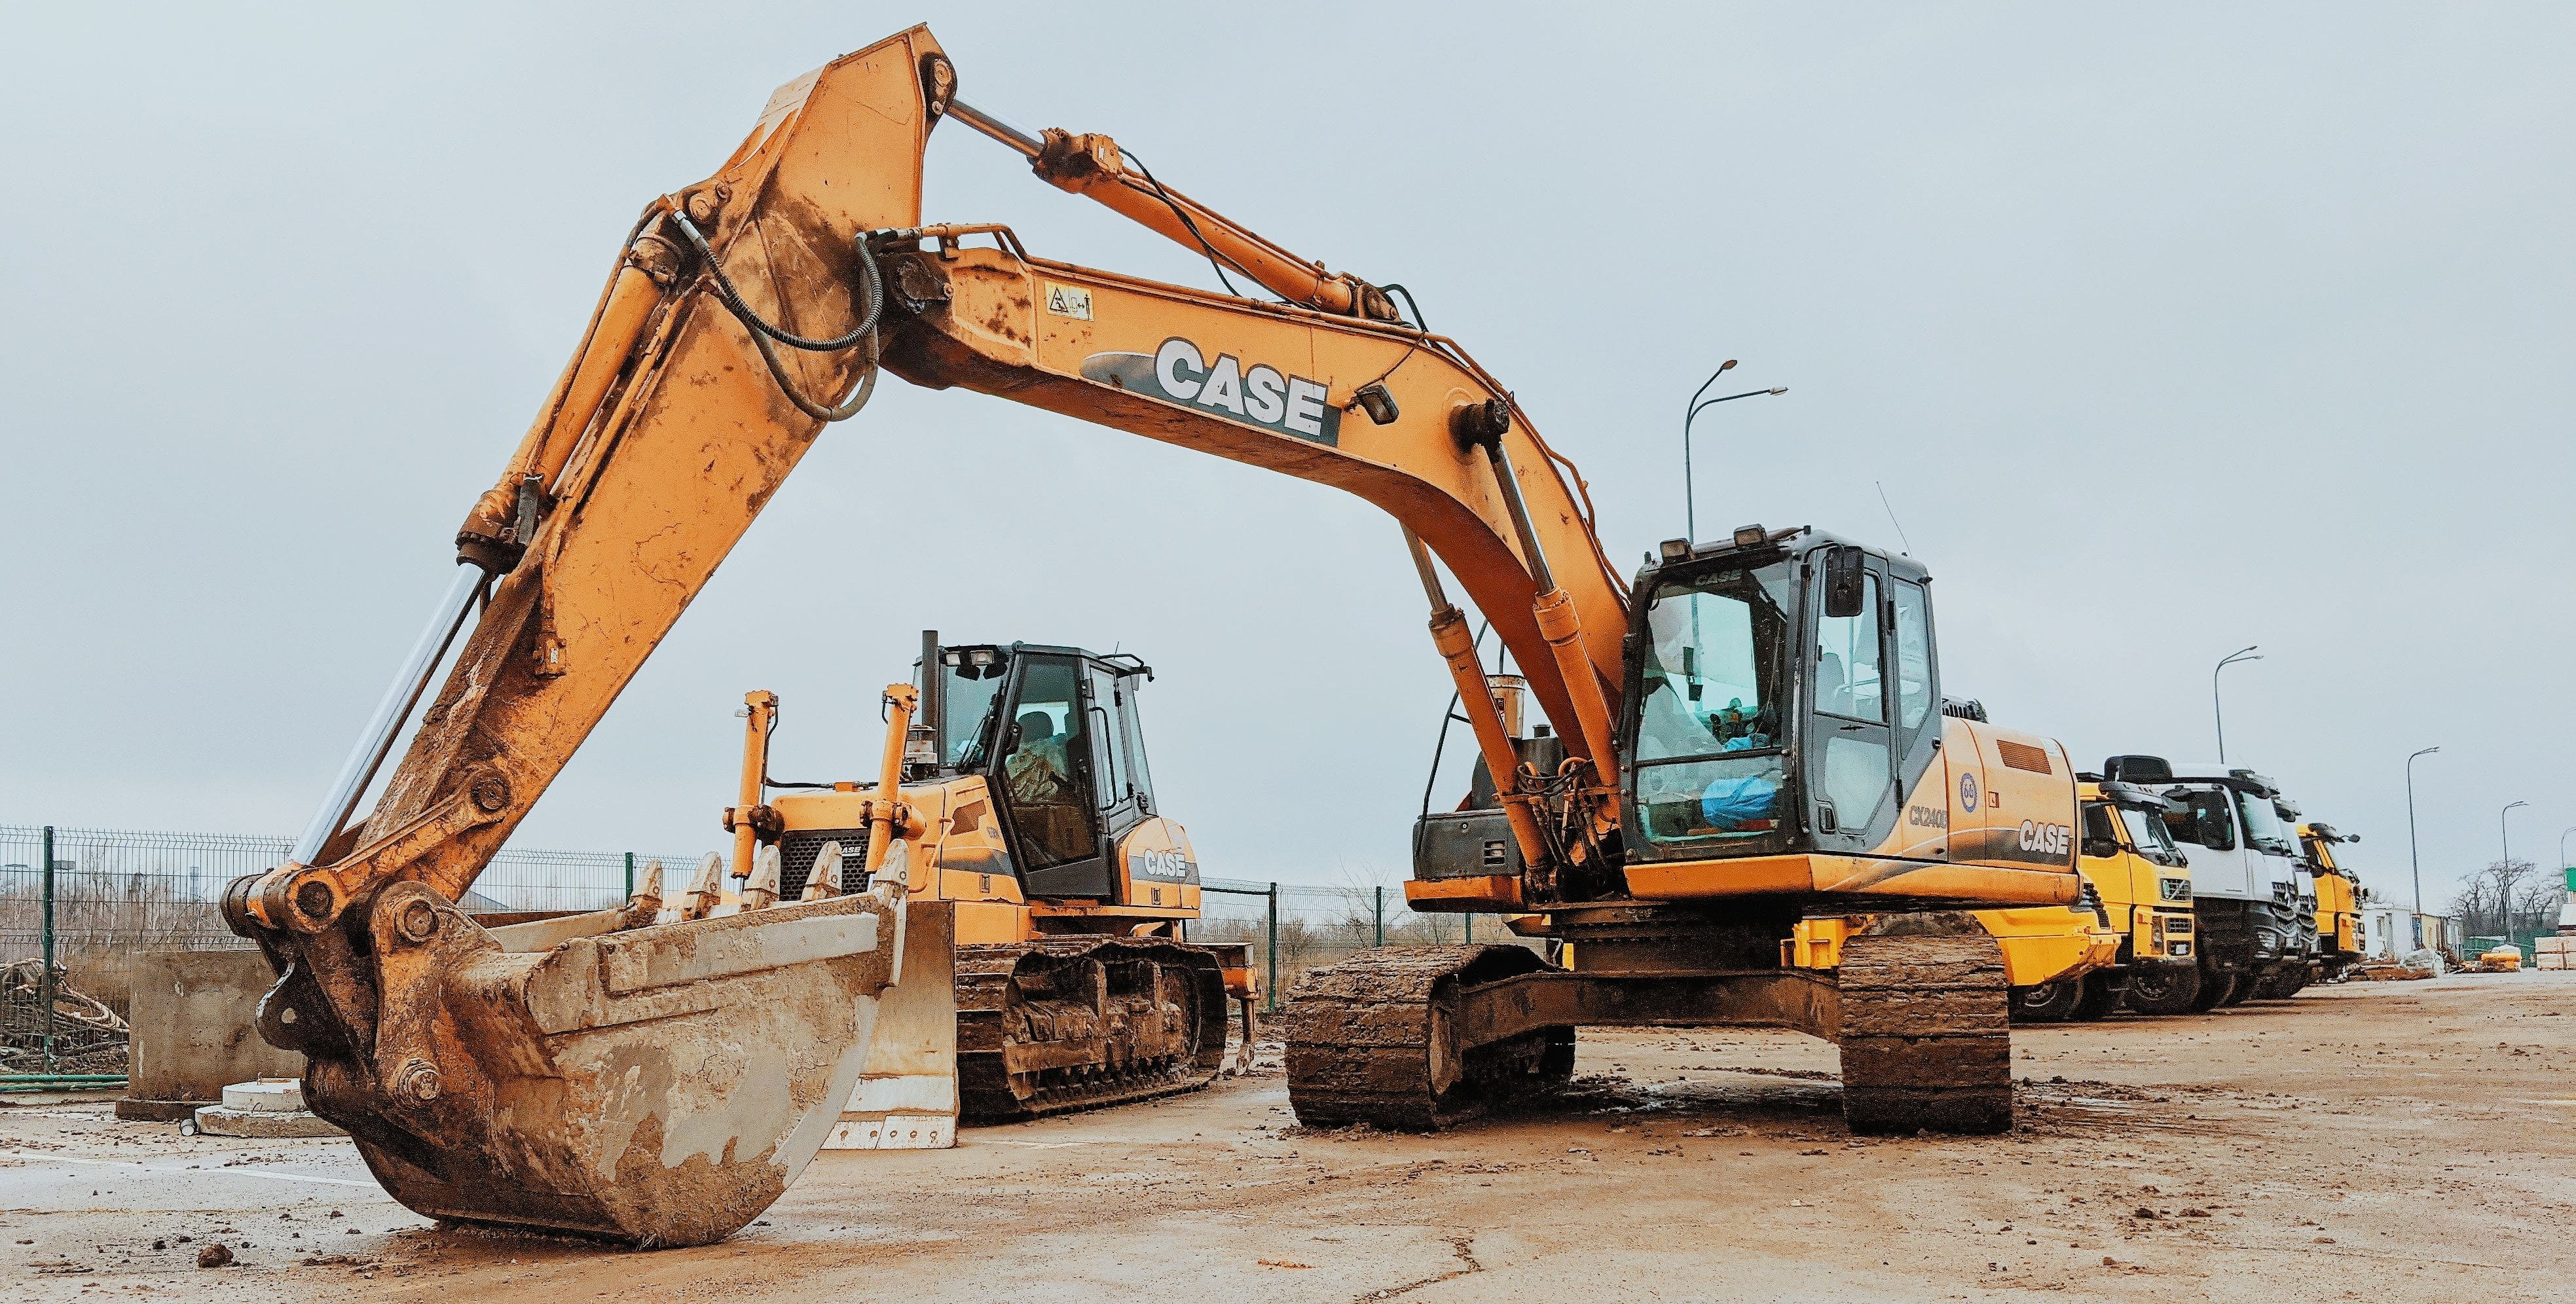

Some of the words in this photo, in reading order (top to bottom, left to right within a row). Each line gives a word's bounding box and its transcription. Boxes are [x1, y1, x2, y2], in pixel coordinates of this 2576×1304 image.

[1156, 340, 1326, 436] CASE
[2019, 820, 2069, 855] CASE
[1145, 850, 1185, 877] CASE
